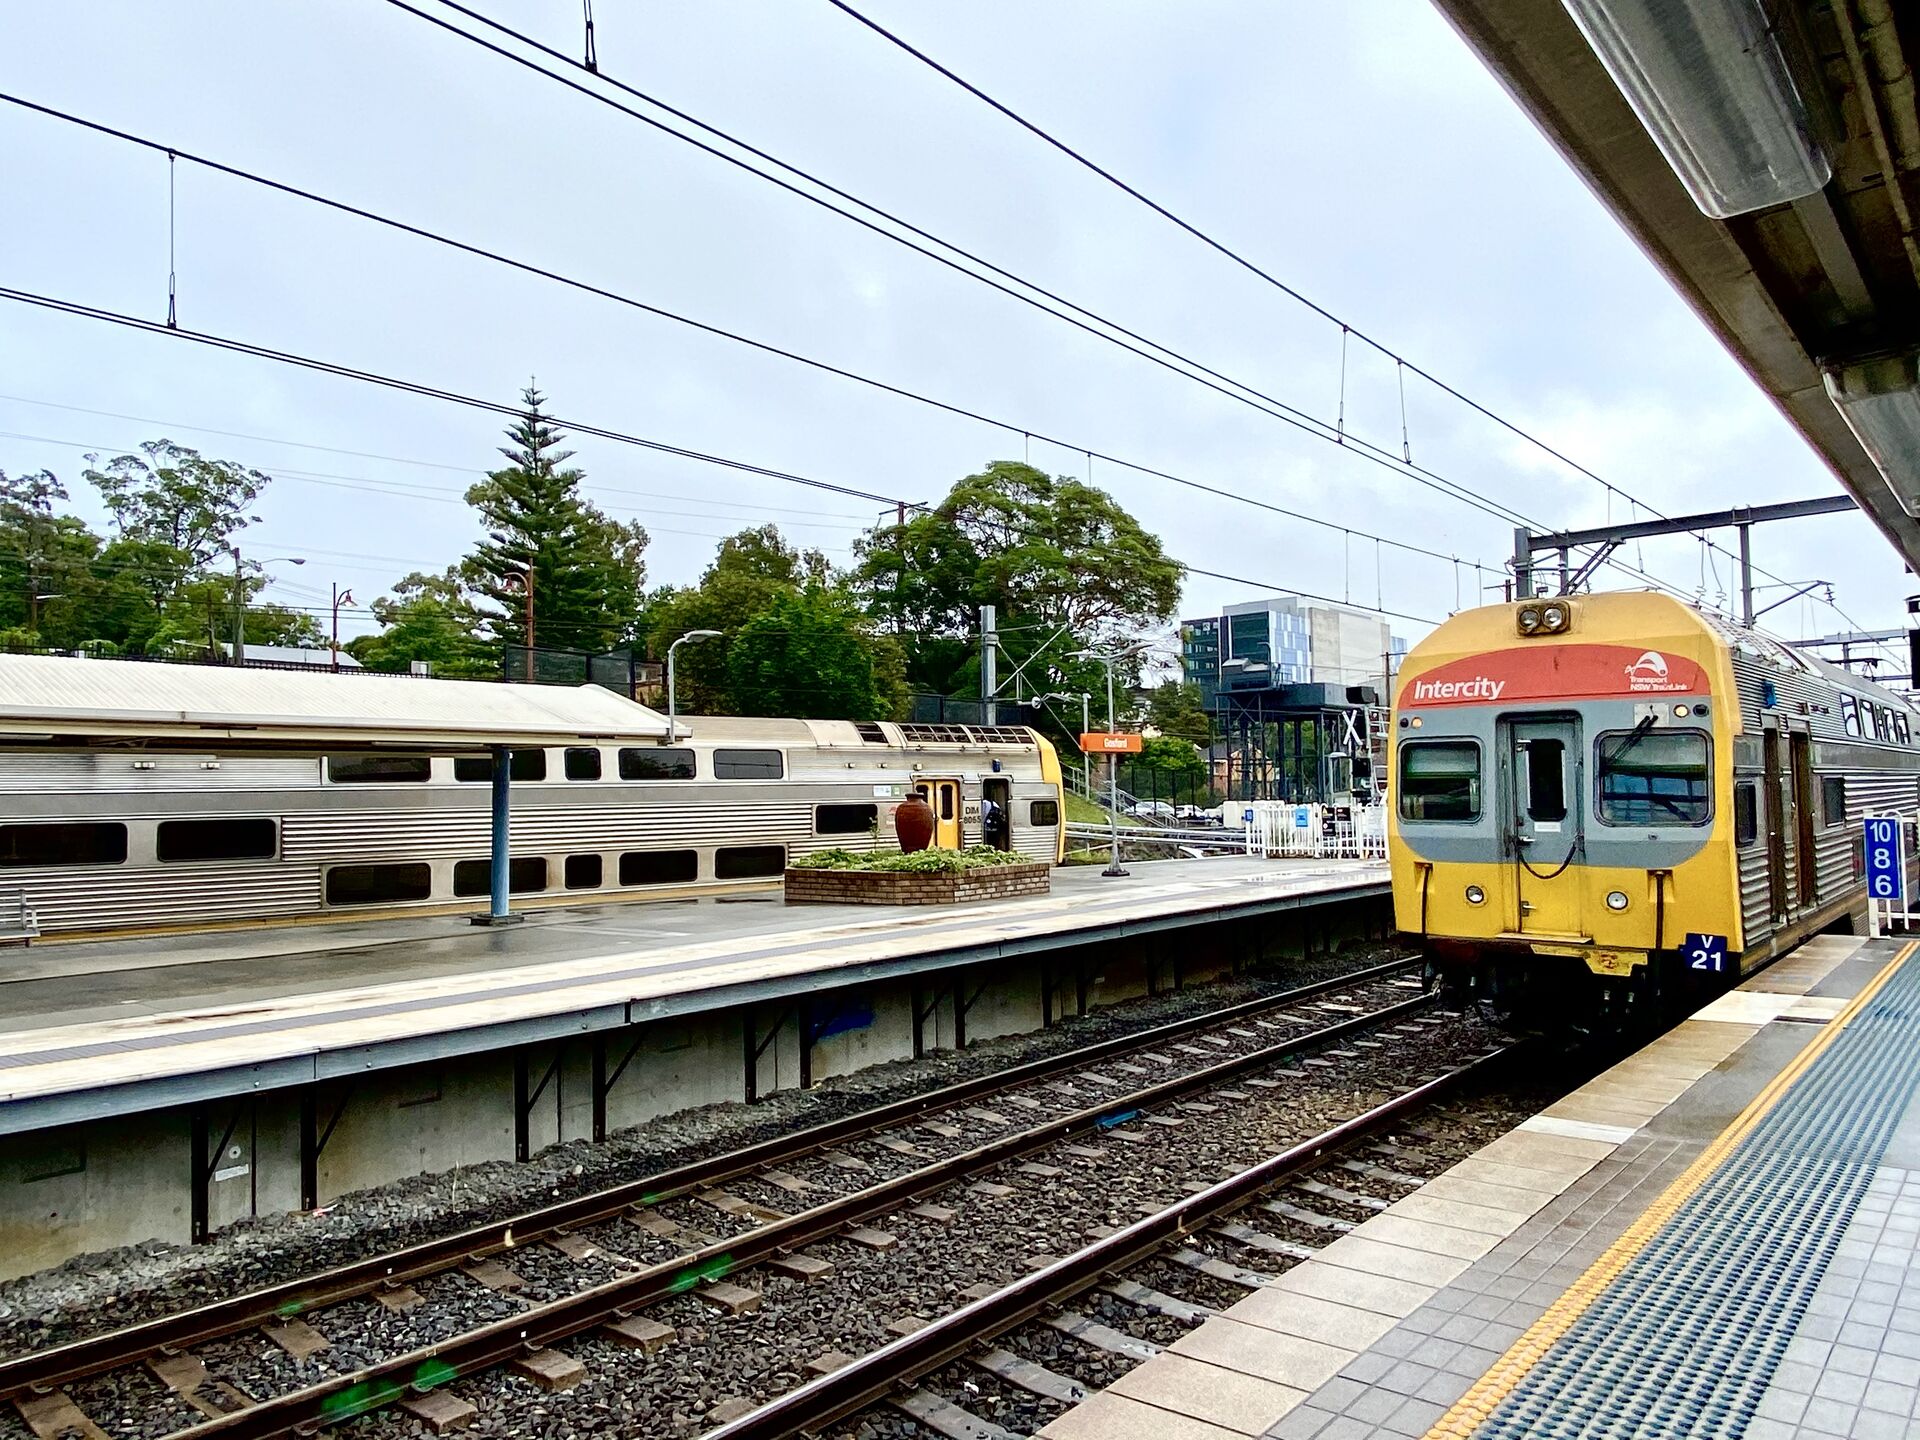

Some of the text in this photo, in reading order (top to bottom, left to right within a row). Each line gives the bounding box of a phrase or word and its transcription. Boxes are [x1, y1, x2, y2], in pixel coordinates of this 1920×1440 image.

[1414, 676, 1505, 701] Intercity
[1869, 821, 1891, 843] 10
[1874, 848, 1891, 869] 8
[1875, 874, 1893, 896] 6
[1701, 935, 1714, 949] V
[1691, 950, 1722, 972] 21
